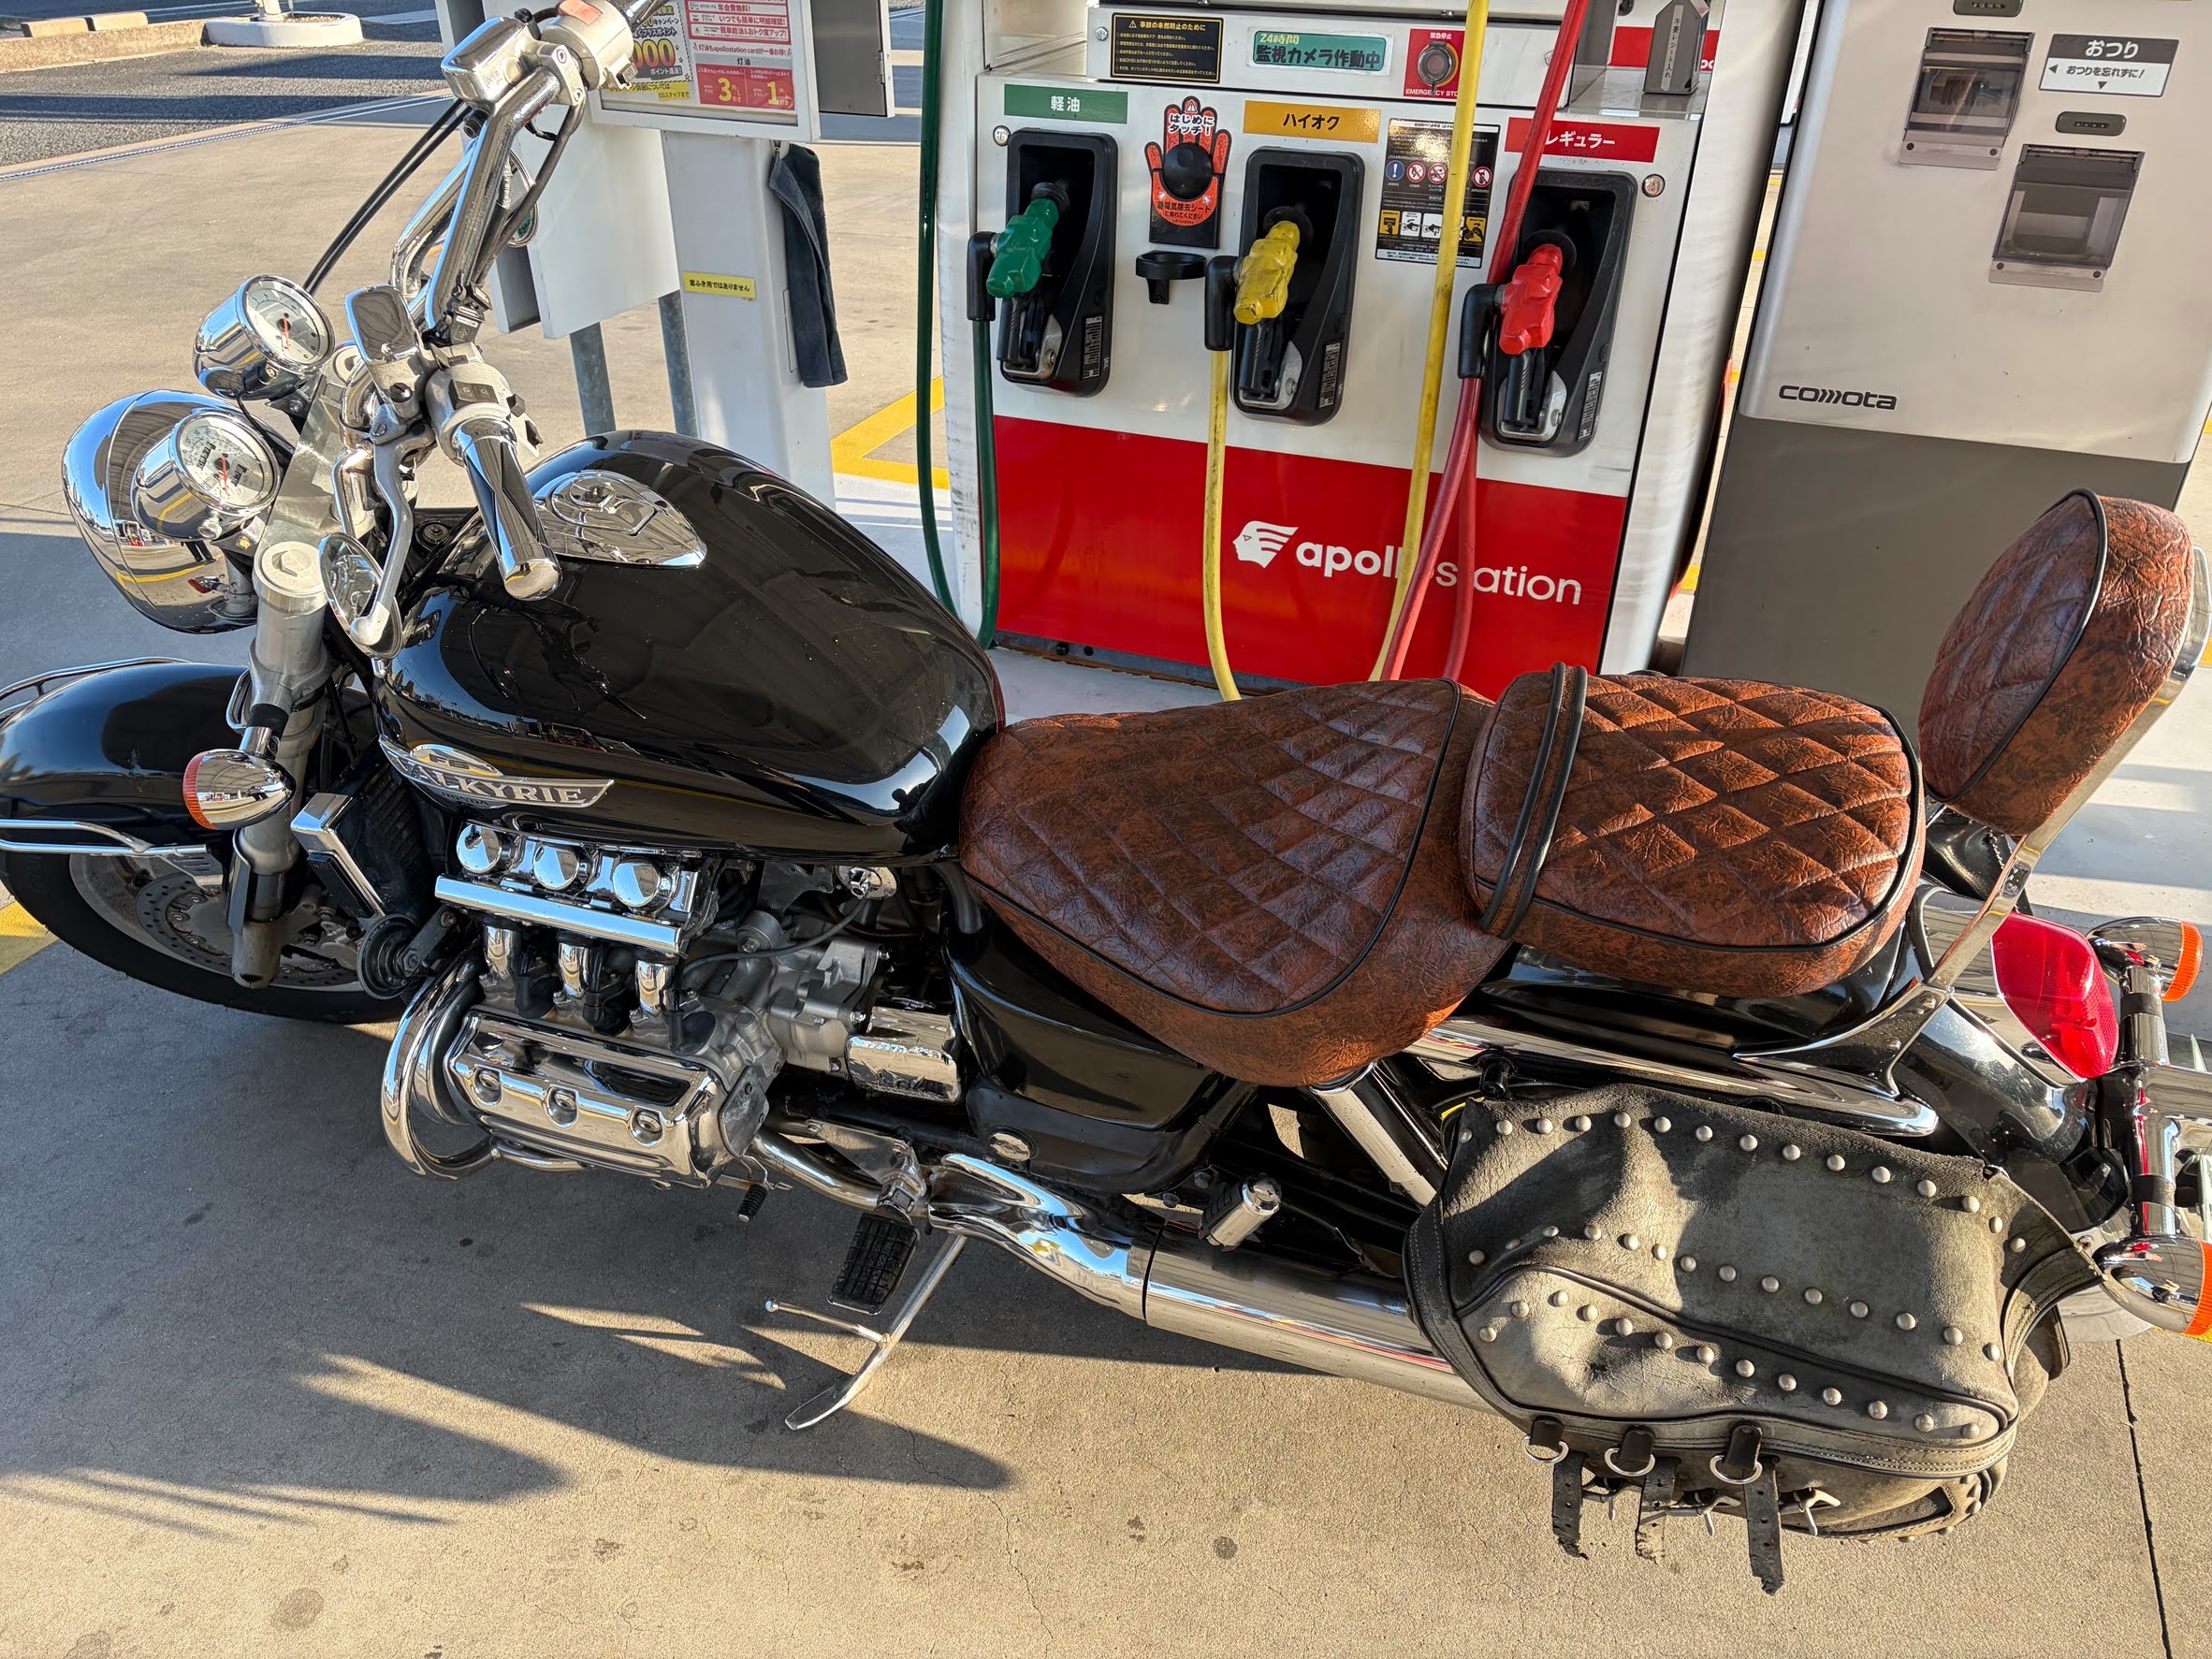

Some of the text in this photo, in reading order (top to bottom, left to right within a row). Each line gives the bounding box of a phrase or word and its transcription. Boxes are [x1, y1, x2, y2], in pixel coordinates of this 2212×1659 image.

[1259, 34, 1300, 45] 24時間
[1430, 32, 1452, 40] 緊急停止
[1256, 45, 1380, 69] 監視カメラ作動中
[2085, 39, 2139, 59] おつり
[737, 57, 750, 66] 灯油
[2066, 65, 2146, 79] おつりを忘れずに!
[718, 78, 732, 102] 3
[766, 81, 779, 106] 1
[1405, 88, 1446, 96] EMERGECY
[1050, 95, 1081, 112] 軽油
[1170, 114, 1215, 125] はじめに
[1282, 113, 1340, 131] ハイオク
[1169, 124, 1211, 136] タッチ！
[1544, 130, 1616, 149] レギュラー
[1296, 540, 1582, 605] apollsation
[387, 749, 589, 805] VALKYRIE
